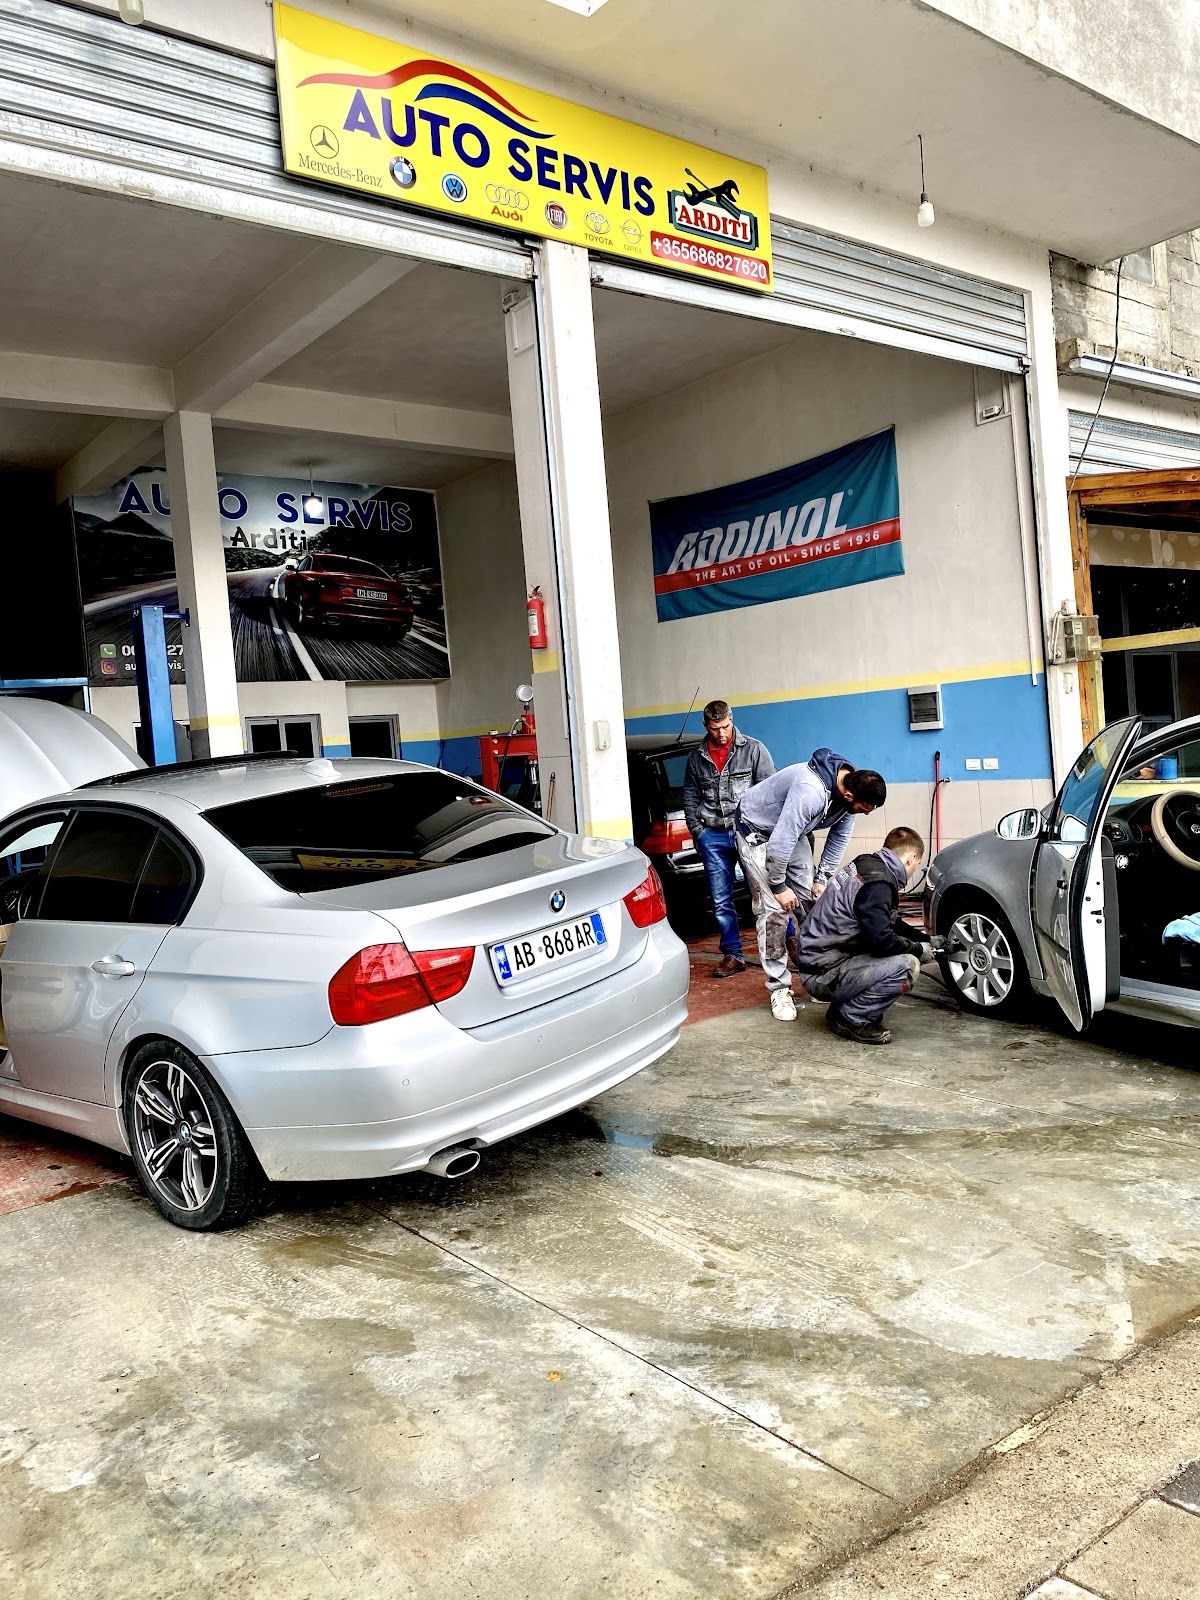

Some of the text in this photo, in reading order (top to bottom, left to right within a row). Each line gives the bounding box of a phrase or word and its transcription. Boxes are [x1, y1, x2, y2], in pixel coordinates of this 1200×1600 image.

[298, 153, 383, 187] Mercedes-Benz
[343, 89, 655, 216] AUTO SERVIS
[491, 205, 523, 222] Audi
[550, 208, 563, 223] FIAT
[677, 204, 749, 240] ARDITI
[584, 233, 613, 246] TOYOTA
[624, 244, 643, 254] OPEL
[653, 237, 767, 280] +355686827620
[118, 480, 412, 532] AUO SERVIS
[230, 526, 308, 551] Arditi
[695, 570, 716, 581] THE
[721, 565, 742, 577] ART
[748, 559, 763, 570] OF
[847, 530, 880, 547] 1936
[513, 922, 596, 971] AB 868 AR
